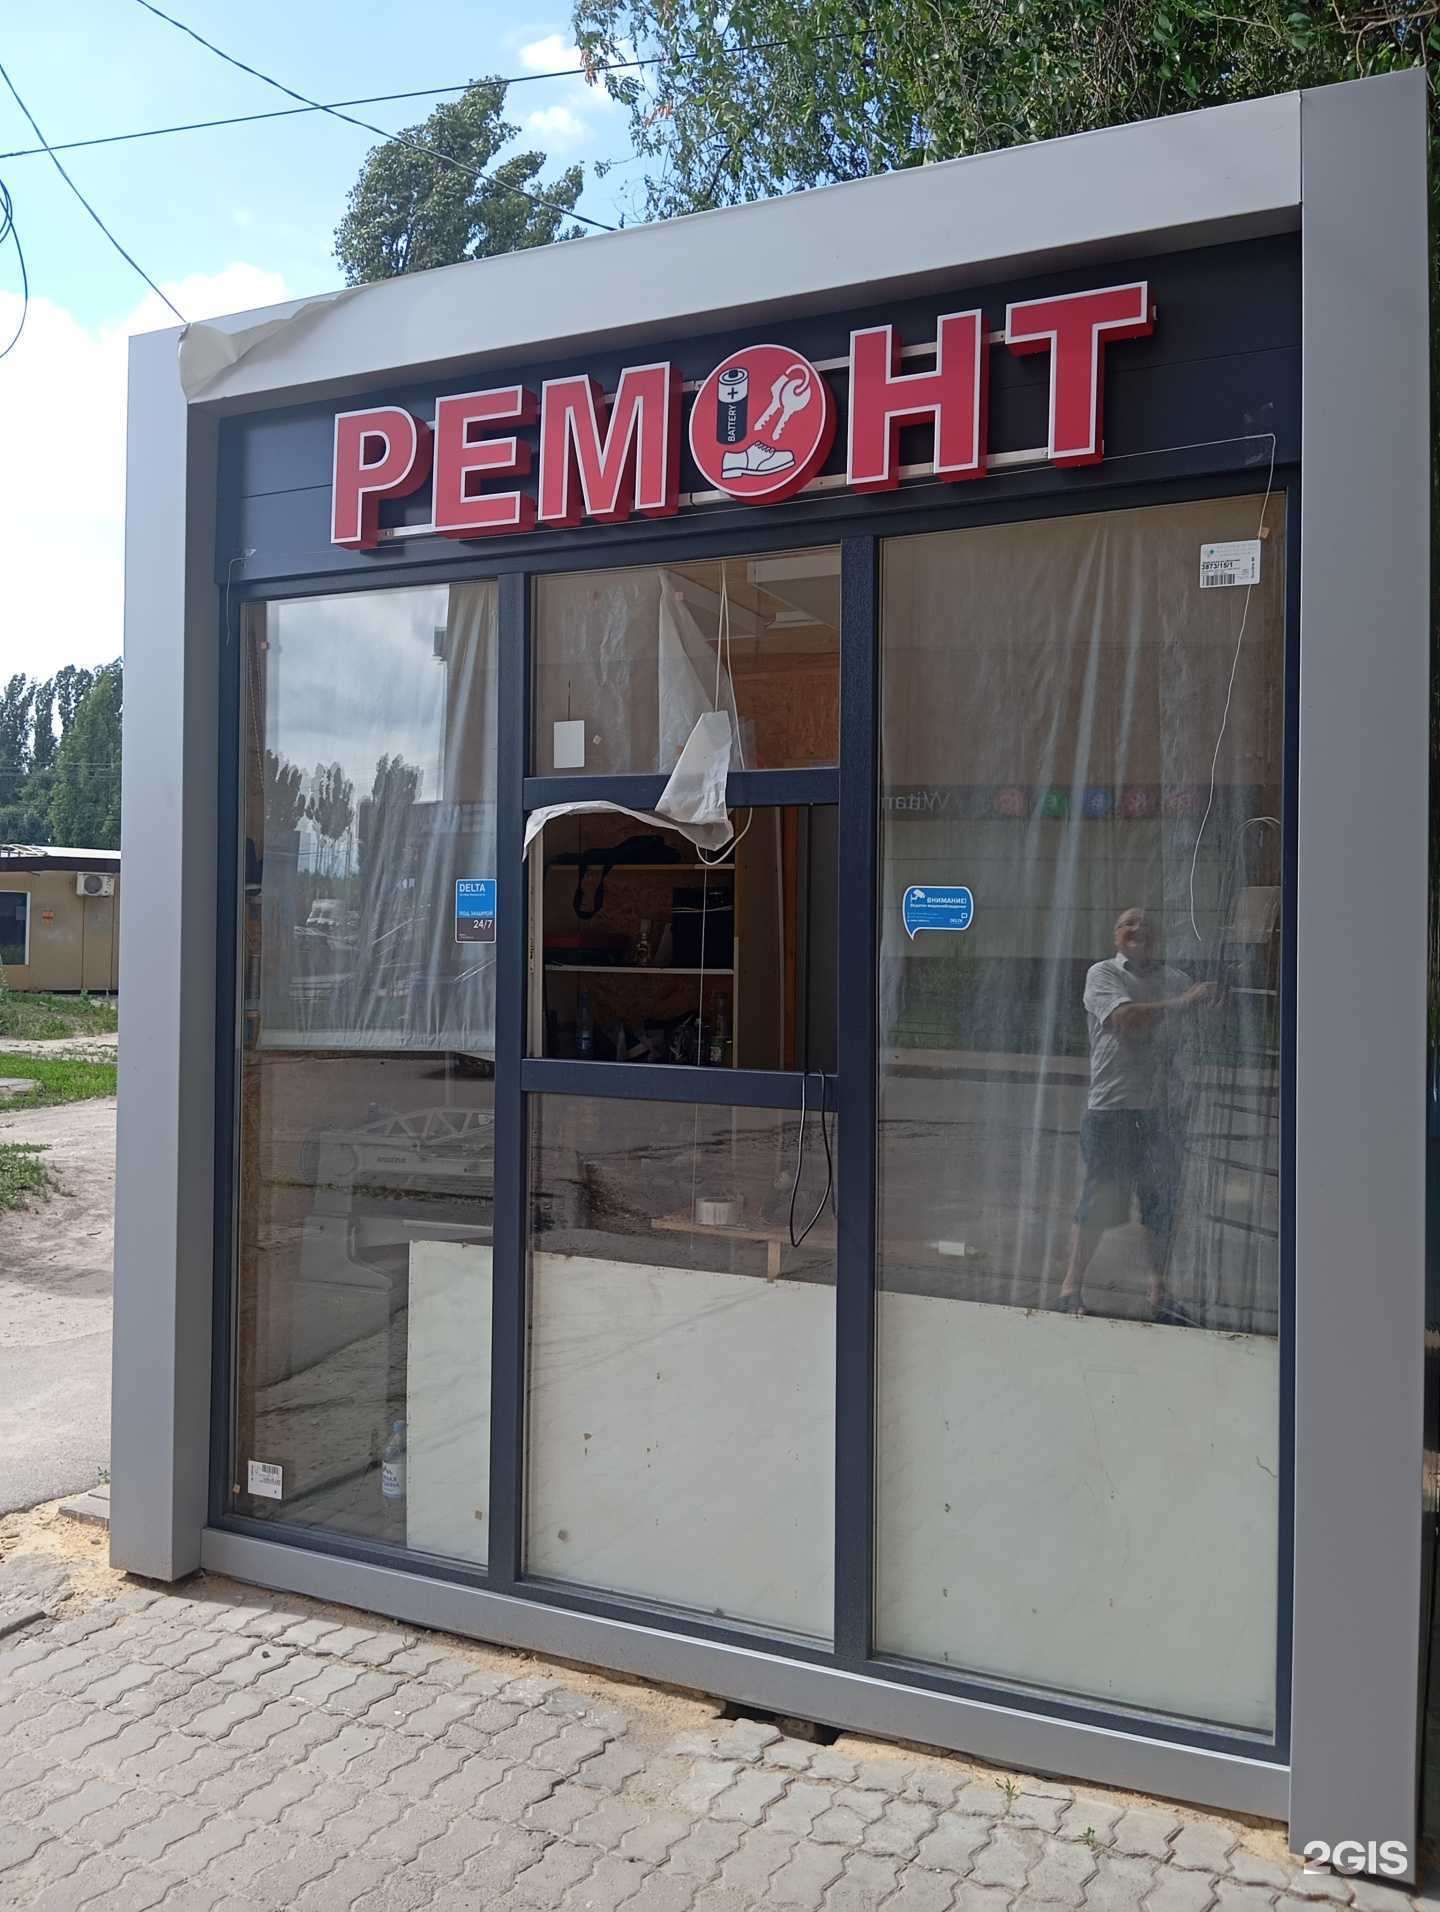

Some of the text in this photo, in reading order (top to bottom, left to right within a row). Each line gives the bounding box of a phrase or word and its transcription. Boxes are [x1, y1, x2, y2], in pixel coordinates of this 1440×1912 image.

[330, 281, 1152, 547] РЕМОНТ
[728, 405, 737, 442] BATTERY
[459, 883, 485, 892] DELTA
[473, 920, 493, 929] 24/7
